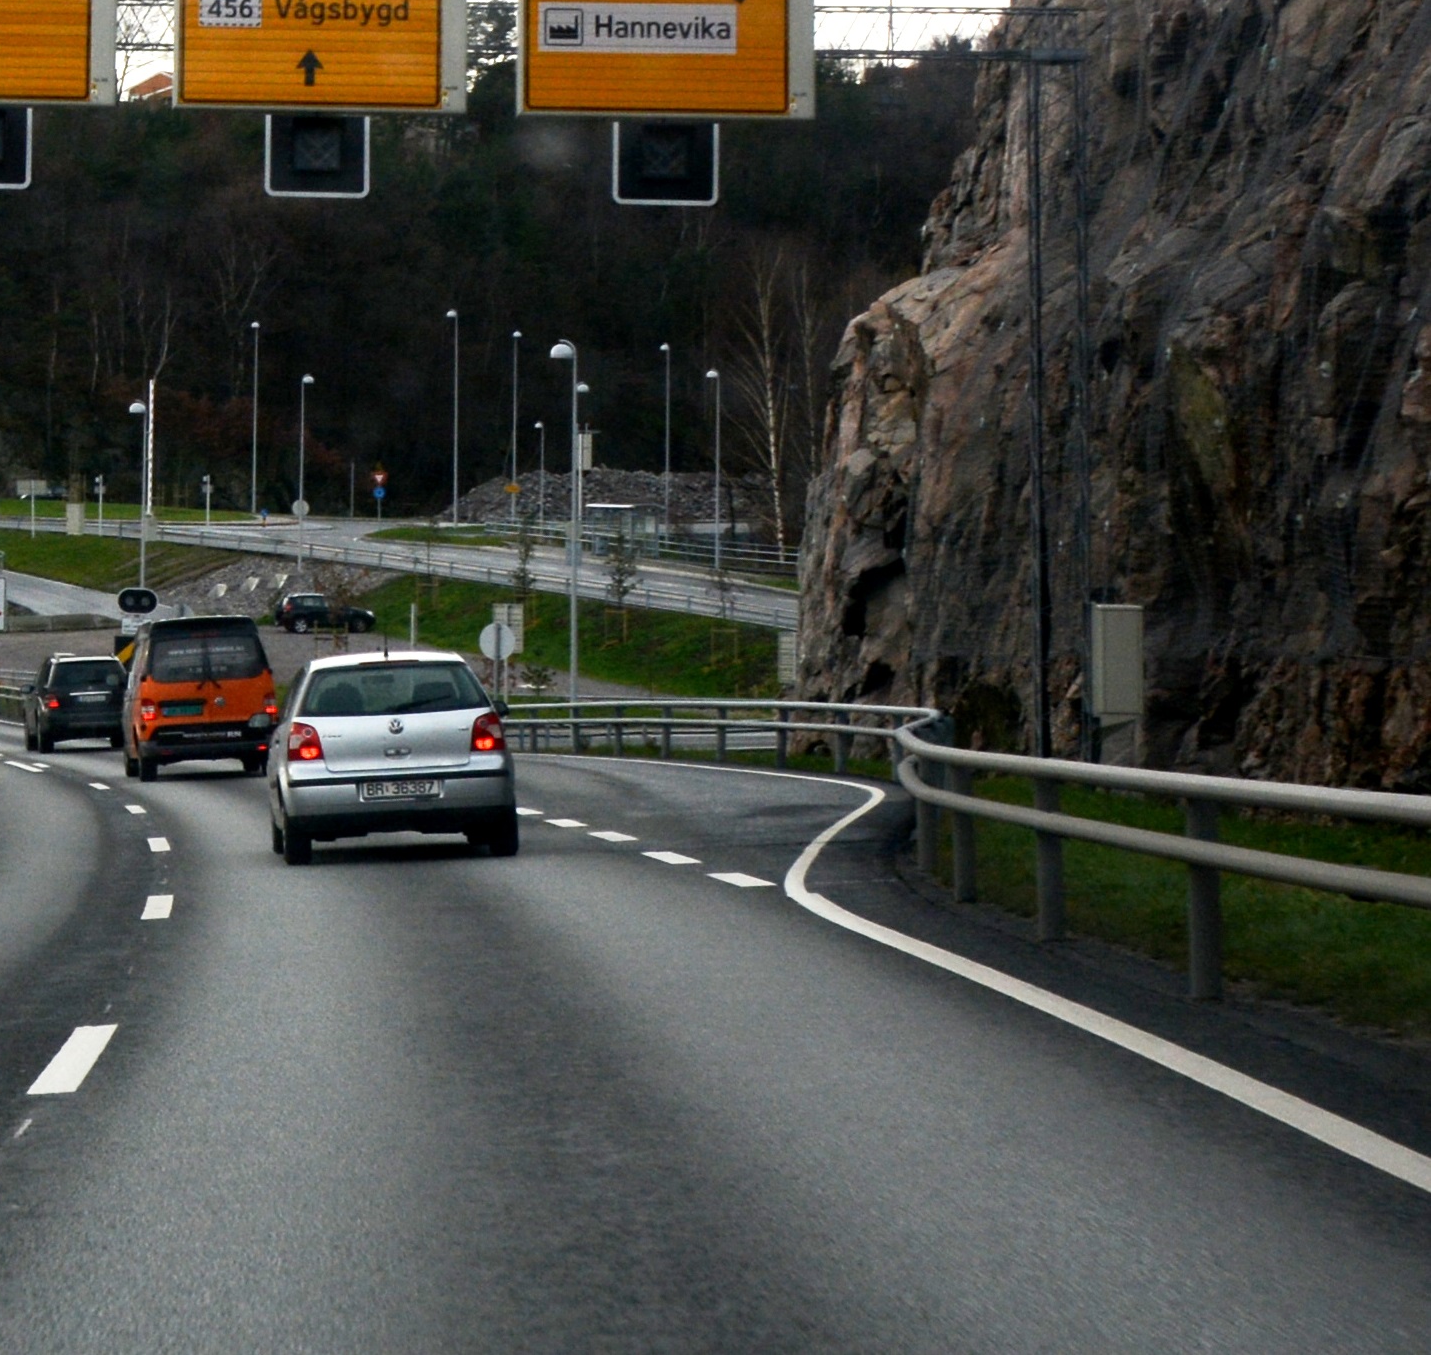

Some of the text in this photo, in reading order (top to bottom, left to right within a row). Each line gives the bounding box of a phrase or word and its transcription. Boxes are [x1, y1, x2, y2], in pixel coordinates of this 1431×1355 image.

[594, 14, 732, 40] Hannevika
[366, 780, 435, 797] BR 36387
